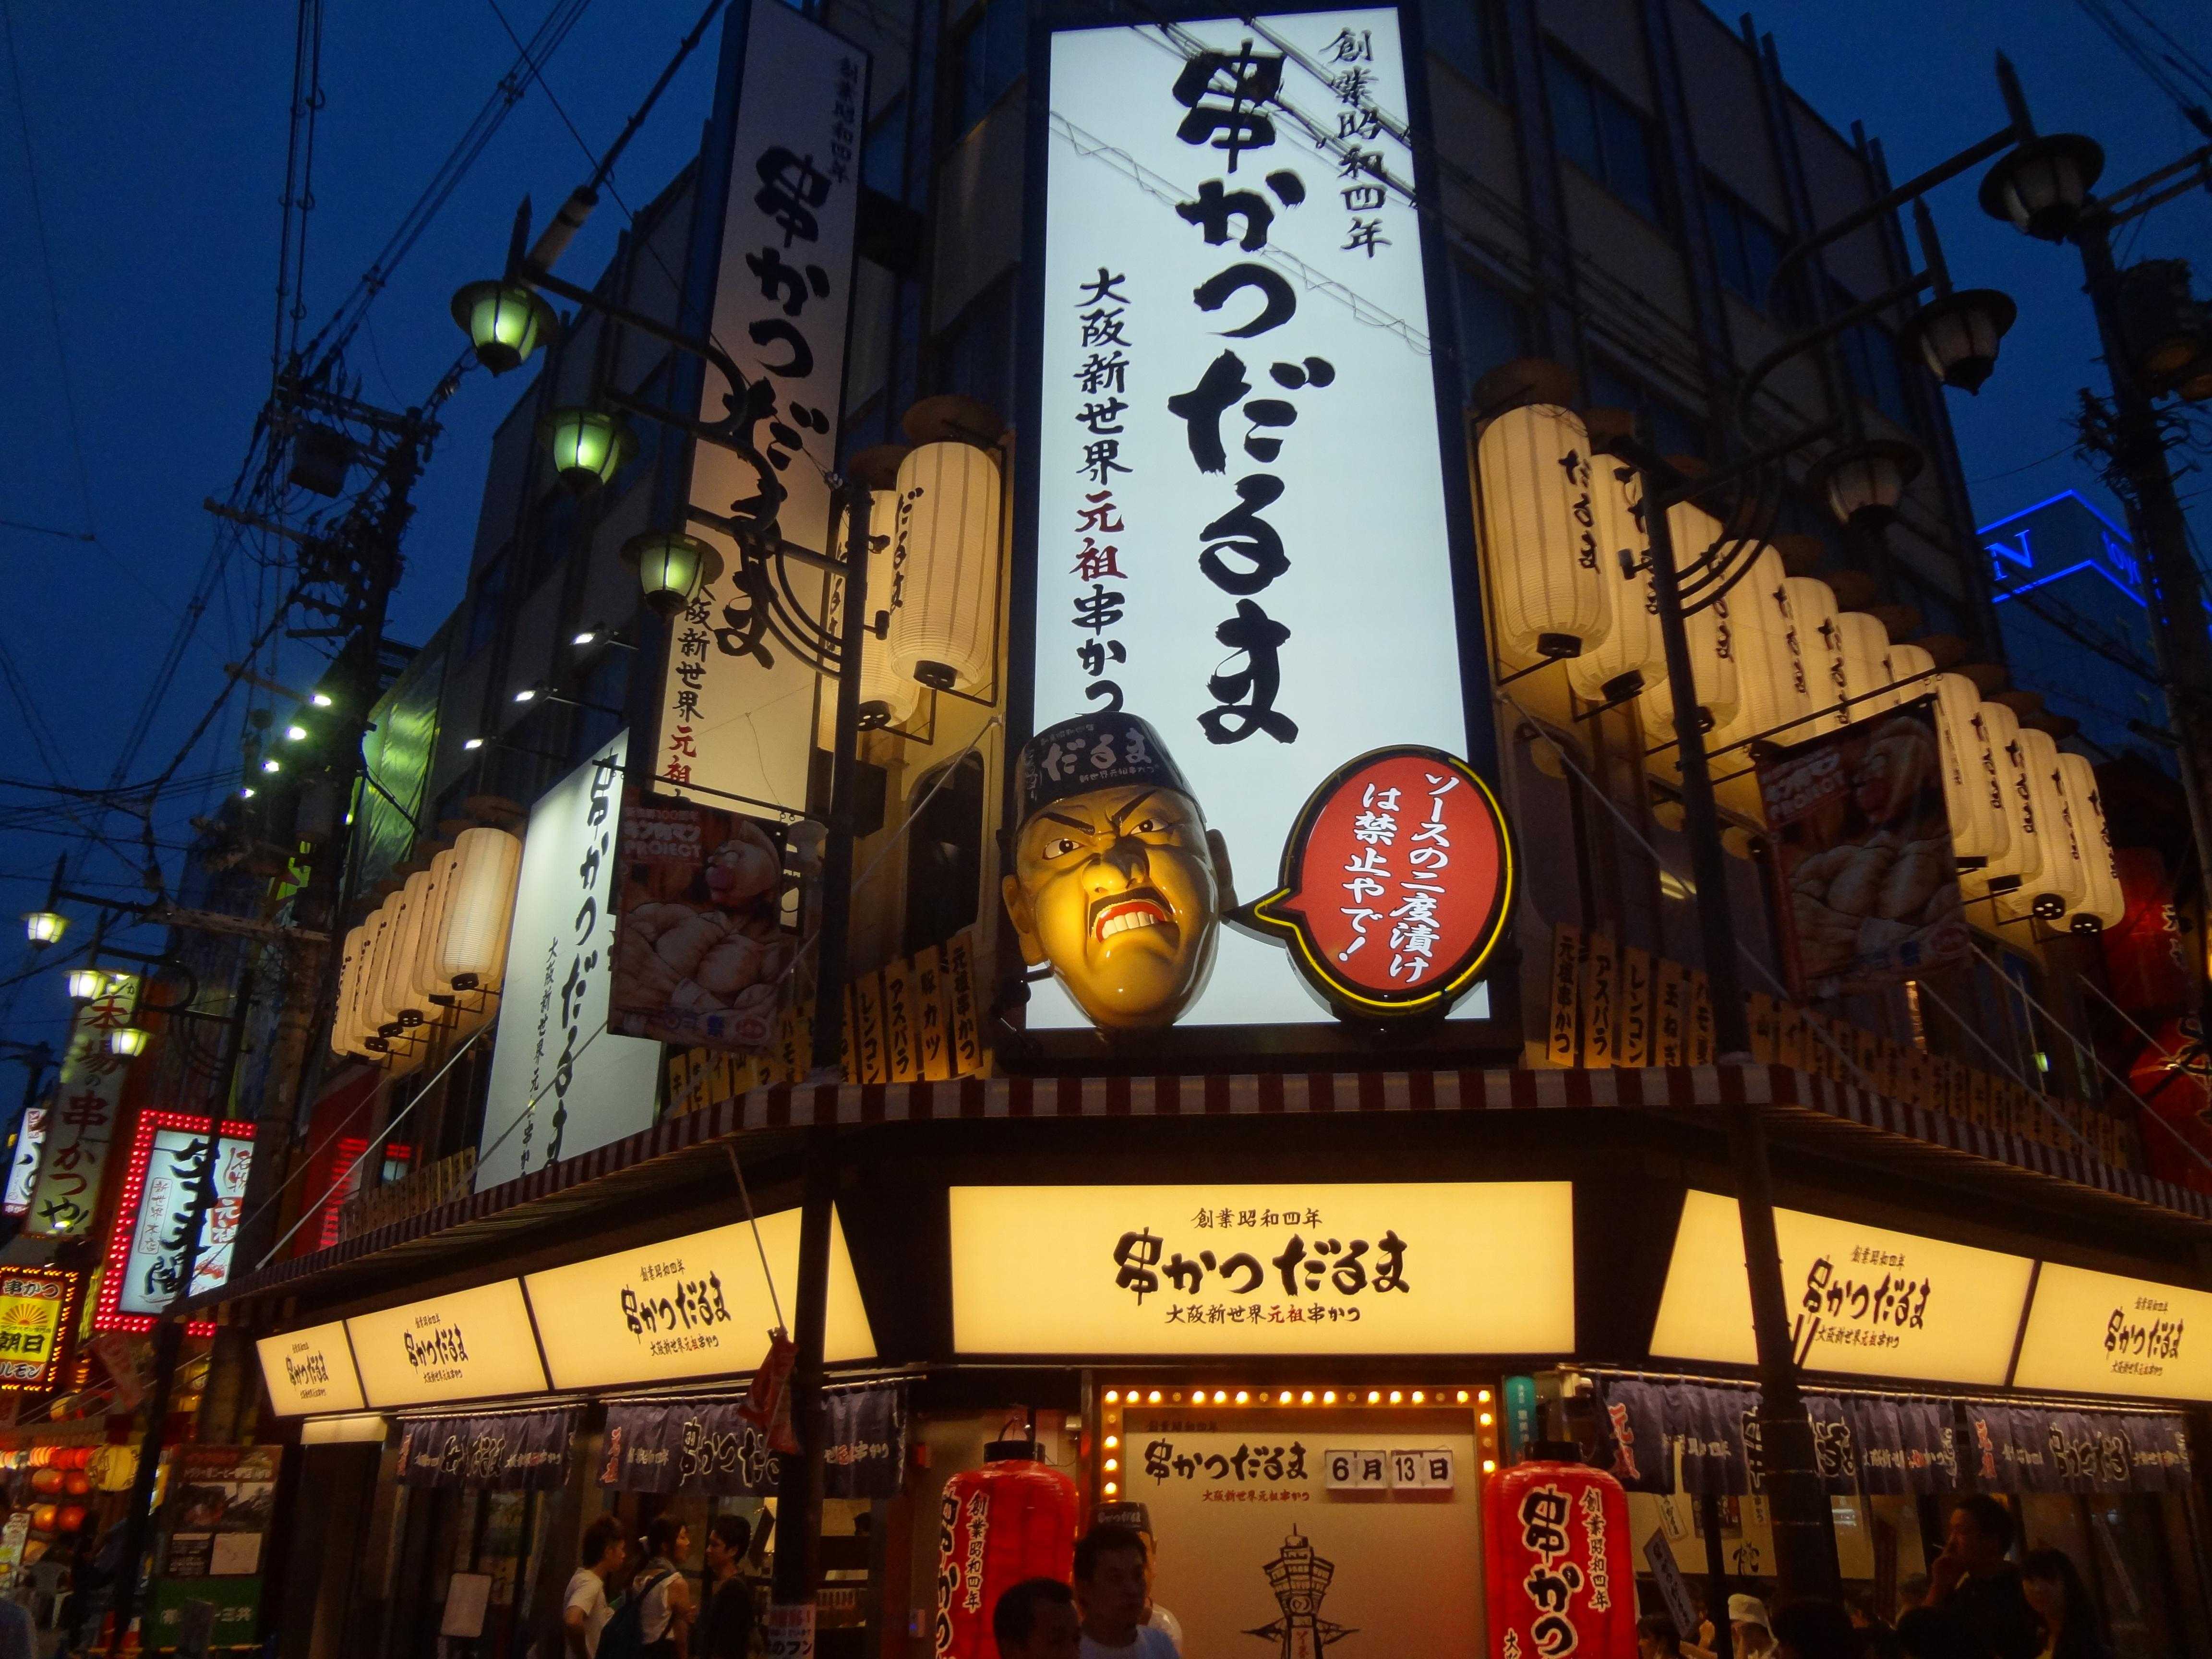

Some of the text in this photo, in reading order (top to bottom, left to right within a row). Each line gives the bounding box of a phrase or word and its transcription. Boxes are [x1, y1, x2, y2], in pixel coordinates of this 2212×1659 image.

[1319, 26, 1393, 258] 創業昭和四年
[1167, 38, 1336, 745] 串かつだるま
[1069, 267, 1134, 715] 大阪新世界元祖串かつ
[663, 583, 716, 802] 阪新世界元祖
[1041, 727, 1152, 781] だるま
[1338, 783, 1402, 961] は禁止やで！
[1390, 773, 1460, 983] ソースの二度漬け
[544, 747, 618, 1170] 串かつだるま
[1593, 955, 1611, 1056] アスパラ
[521, 937, 558, 1178] 大阪新世界元串か
[861, 992, 880, 1084] レンコン
[890, 978, 910, 1074] アスパラ
[1629, 964, 1645, 1063] レンコン
[1191, 1207, 1323, 1229] 創業昭和四年
[3, 1279, 60, 1298] 串かつ
[620, 1270, 731, 1344] 串かつだるま
[639, 1258, 685, 1283] 創業昭和四年
[1113, 1226, 1410, 1306] 串かつだるま
[1803, 1255, 1930, 1330] 串かつだるま
[0, 1331, 45, 1354] 朝日
[404, 1323, 469, 1375] 串かつだるま
[1165, 1303, 1360, 1325] 大阪新世界元祖串かつ
[2104, 1304, 2184, 1360] 串かつだるま
[285, 1350, 329, 1391] 串かつだるま
[1144, 1438, 1308, 1485] 串かつだるま
[1202, 1488, 1310, 1503] 大阪新世界元祖串かつ
[936, 1486, 961, 1659] 串かつ
[962, 1490, 989, 1613] 創業昭和四年
[1518, 1483, 1584, 1658] 串かつ
[1578, 1486, 1611, 1611] 創業昭和四年
